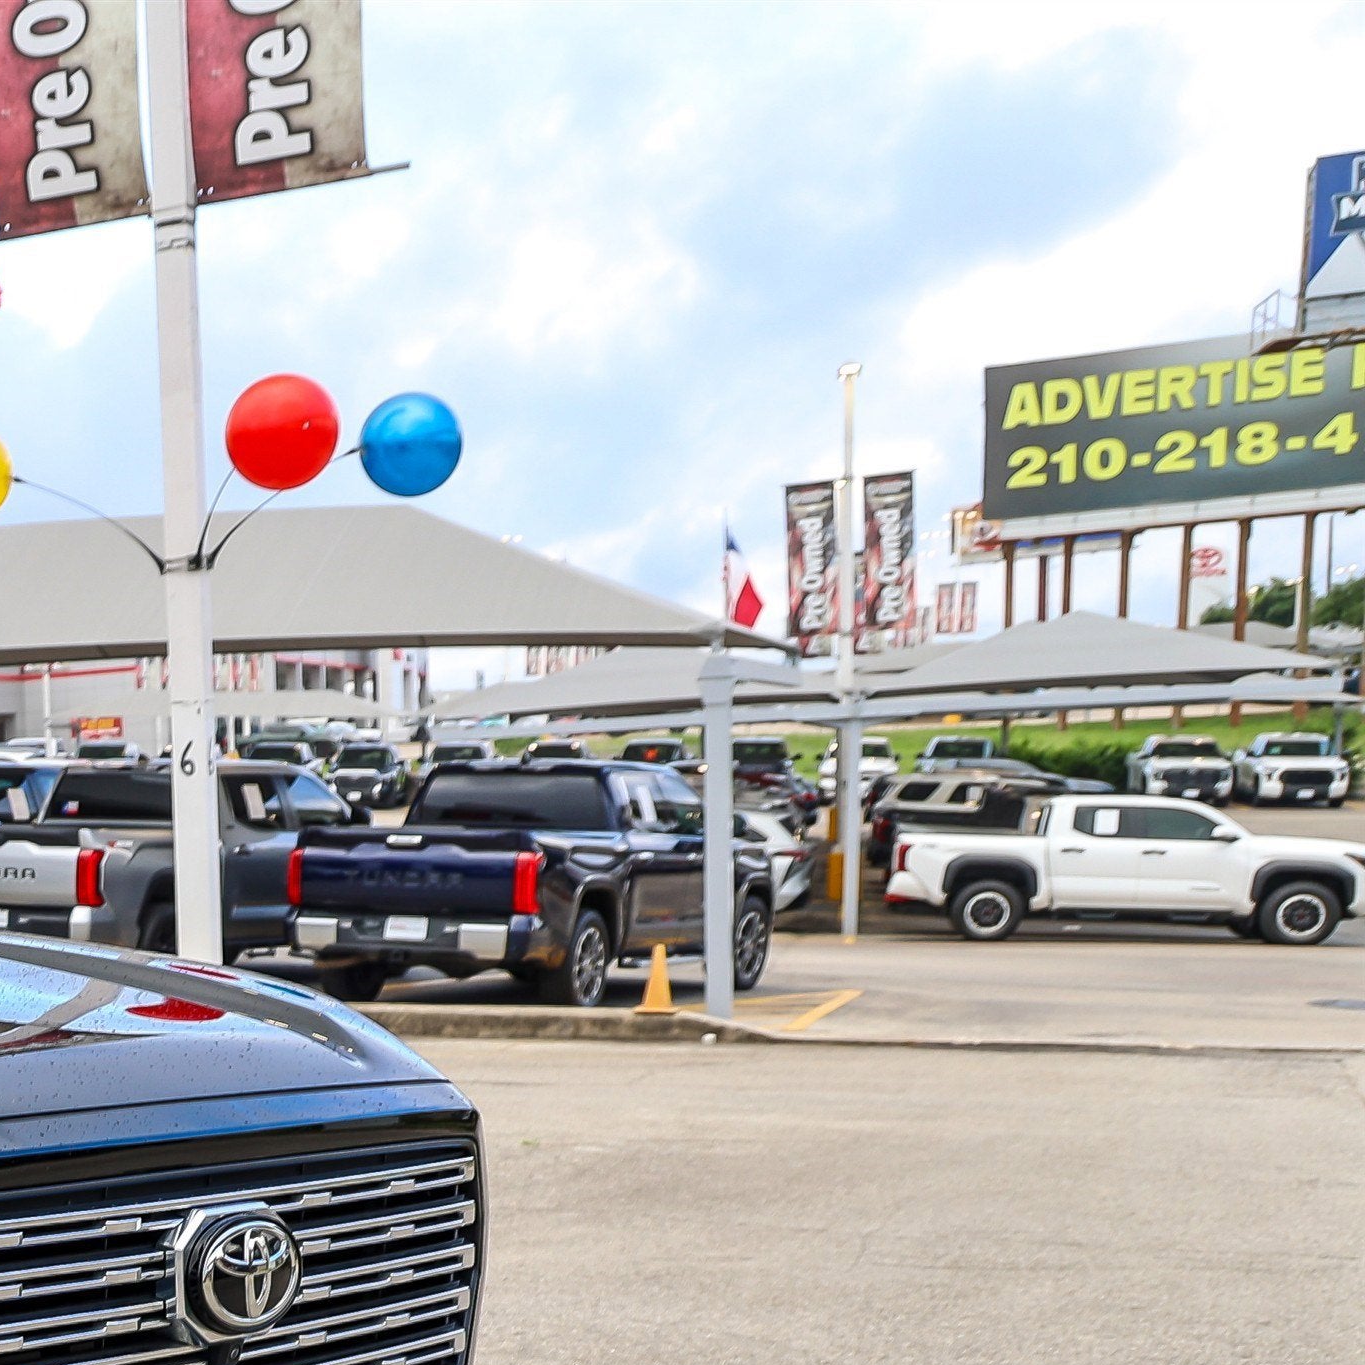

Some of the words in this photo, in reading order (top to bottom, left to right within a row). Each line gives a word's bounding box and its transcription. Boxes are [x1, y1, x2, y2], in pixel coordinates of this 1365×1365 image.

[235, 24, 313, 167] Pre
[26, 65, 99, 203] Pre
[1002, 346, 1327, 431] ADVERTISE
[1006, 411, 1360, 491] 210-218-4
[797, 516, 825, 591] Owned
[873, 508, 901, 582] Owned
[799, 592, 824, 630] Pre
[875, 584, 902, 623] Pre
[181, 740, 195, 776] 6
